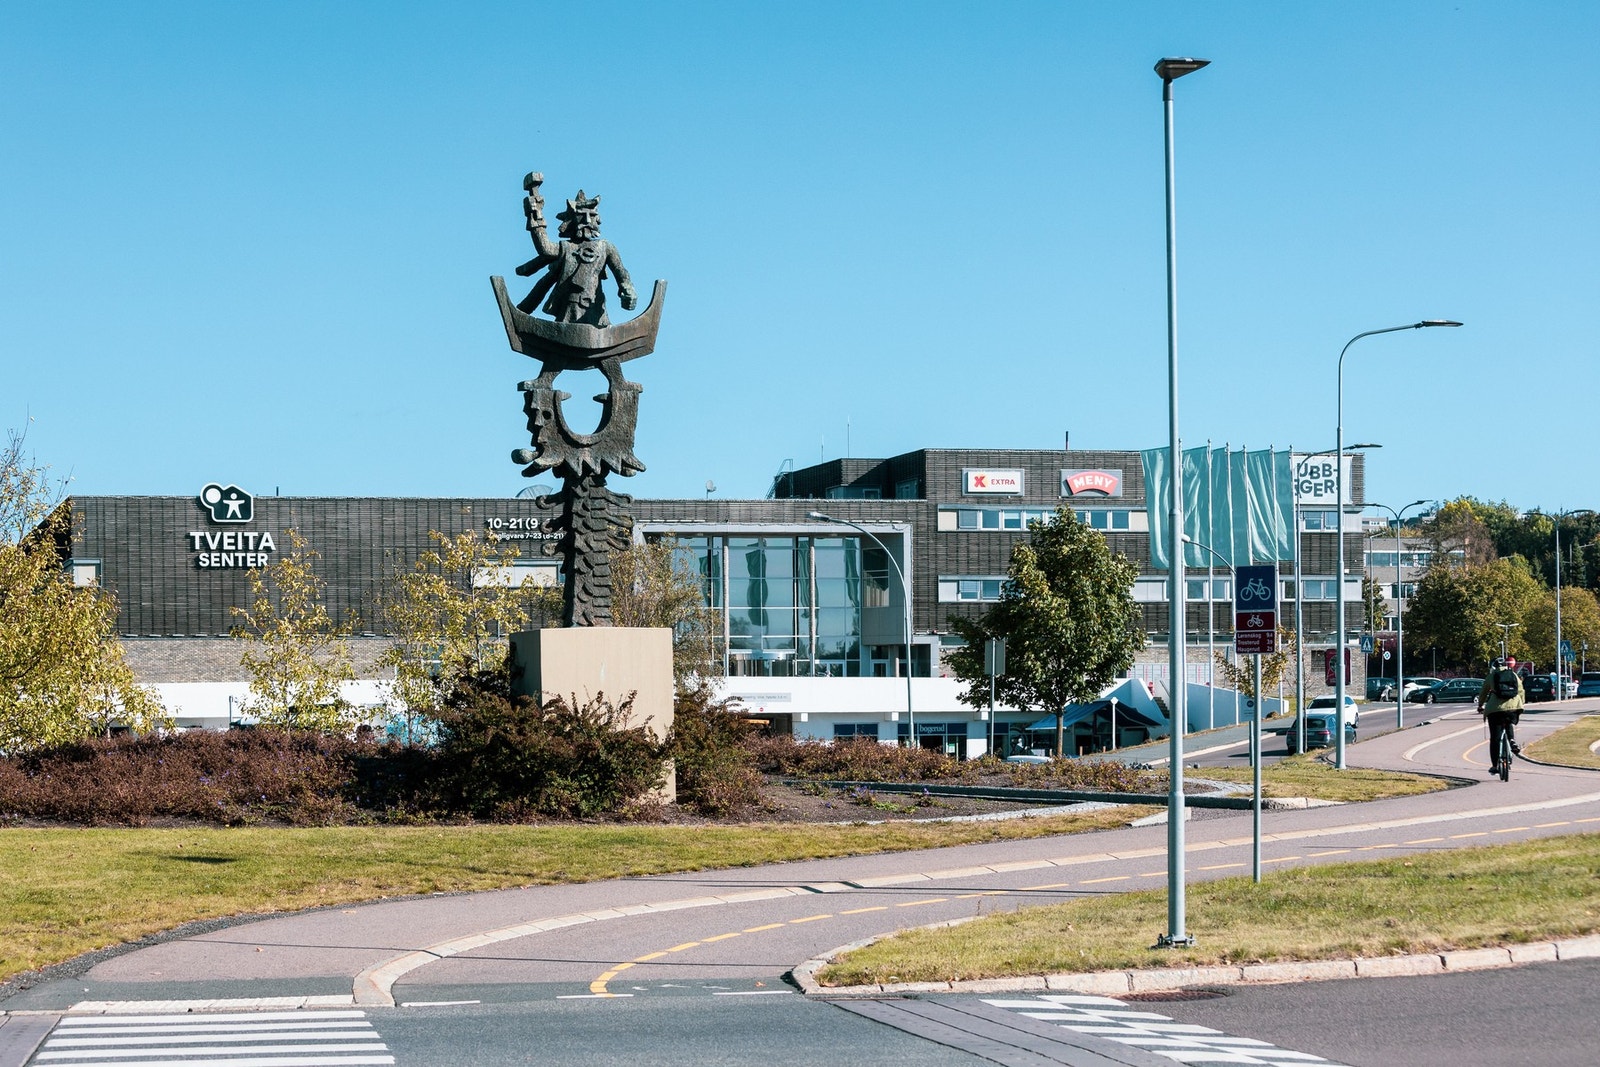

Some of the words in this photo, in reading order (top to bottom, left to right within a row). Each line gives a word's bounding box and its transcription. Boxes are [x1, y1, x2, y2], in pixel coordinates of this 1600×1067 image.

[991, 478, 1016, 486] EXTRA
[1073, 475, 1113, 488] MENY
[189, 531, 276, 550] TVEITA
[198, 552, 268, 567] SENTER
[920, 724, 945, 733] bogerud
